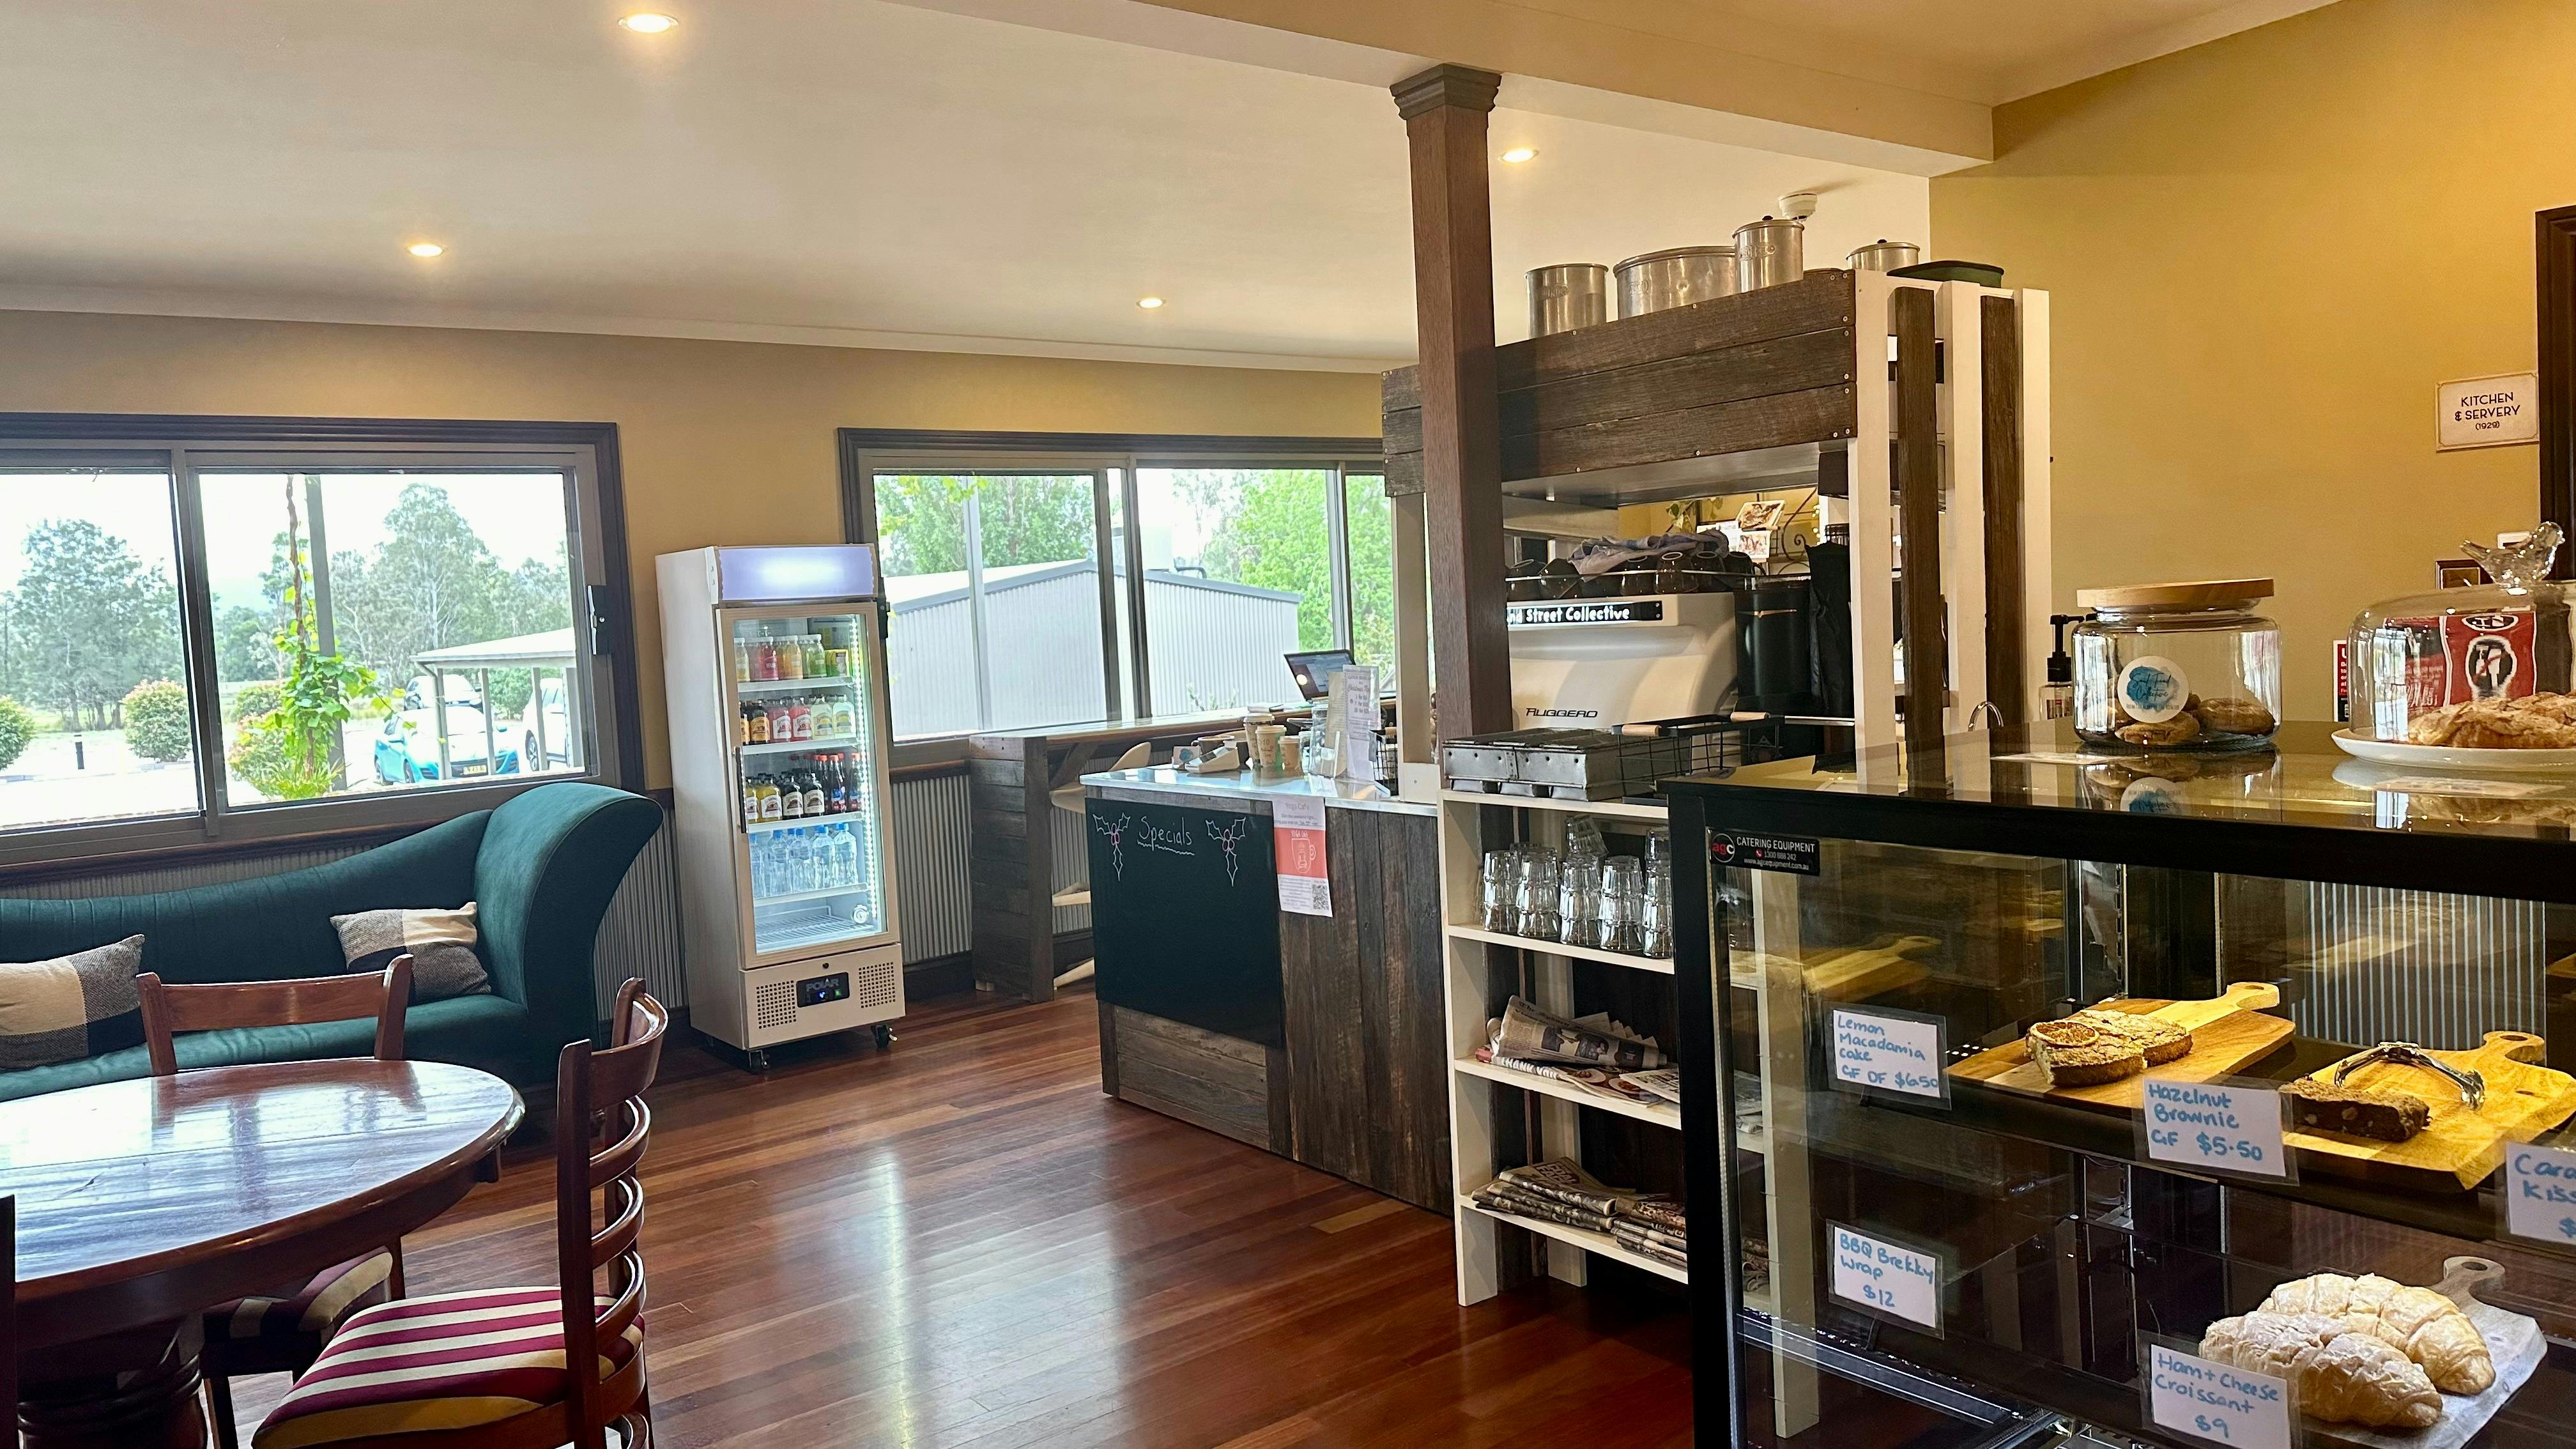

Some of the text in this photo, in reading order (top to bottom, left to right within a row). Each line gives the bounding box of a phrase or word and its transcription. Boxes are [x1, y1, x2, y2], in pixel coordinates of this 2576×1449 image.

[2461, 392, 2514, 407] KITCHEN
[2455, 404, 2521, 422] & SERVERY
[2475, 420, 2500, 431] (1929)
[1526, 607, 1563, 623] Street
[1565, 605, 1630, 622] Collective
[1526, 707, 1598, 718] RUGGERO
[1138, 816, 1192, 851] Specials
[1712, 836, 1816, 855] agc CATERING EQUIPMENT
[806, 977, 839, 992] POLAR
[1837, 1015, 1885, 1036] Lemon
[1839, 1033, 1926, 1061] Macadamia
[2149, 1084, 2232, 1108] Hazelnut
[2154, 1103, 2240, 1129] Brownie
[2150, 1129, 2179, 1146] GF
[1839, 1233, 1934, 1284] BBQ Brekky
[1840, 1255, 1884, 1280] Wrap
[1863, 1284, 1896, 1308] $12
[2158, 1353, 2202, 1380] Ham
[2220, 1373, 2279, 1401] Cheese
[2154, 1374, 2255, 1413] Croissant
[2195, 1414, 2230, 1438] $9
